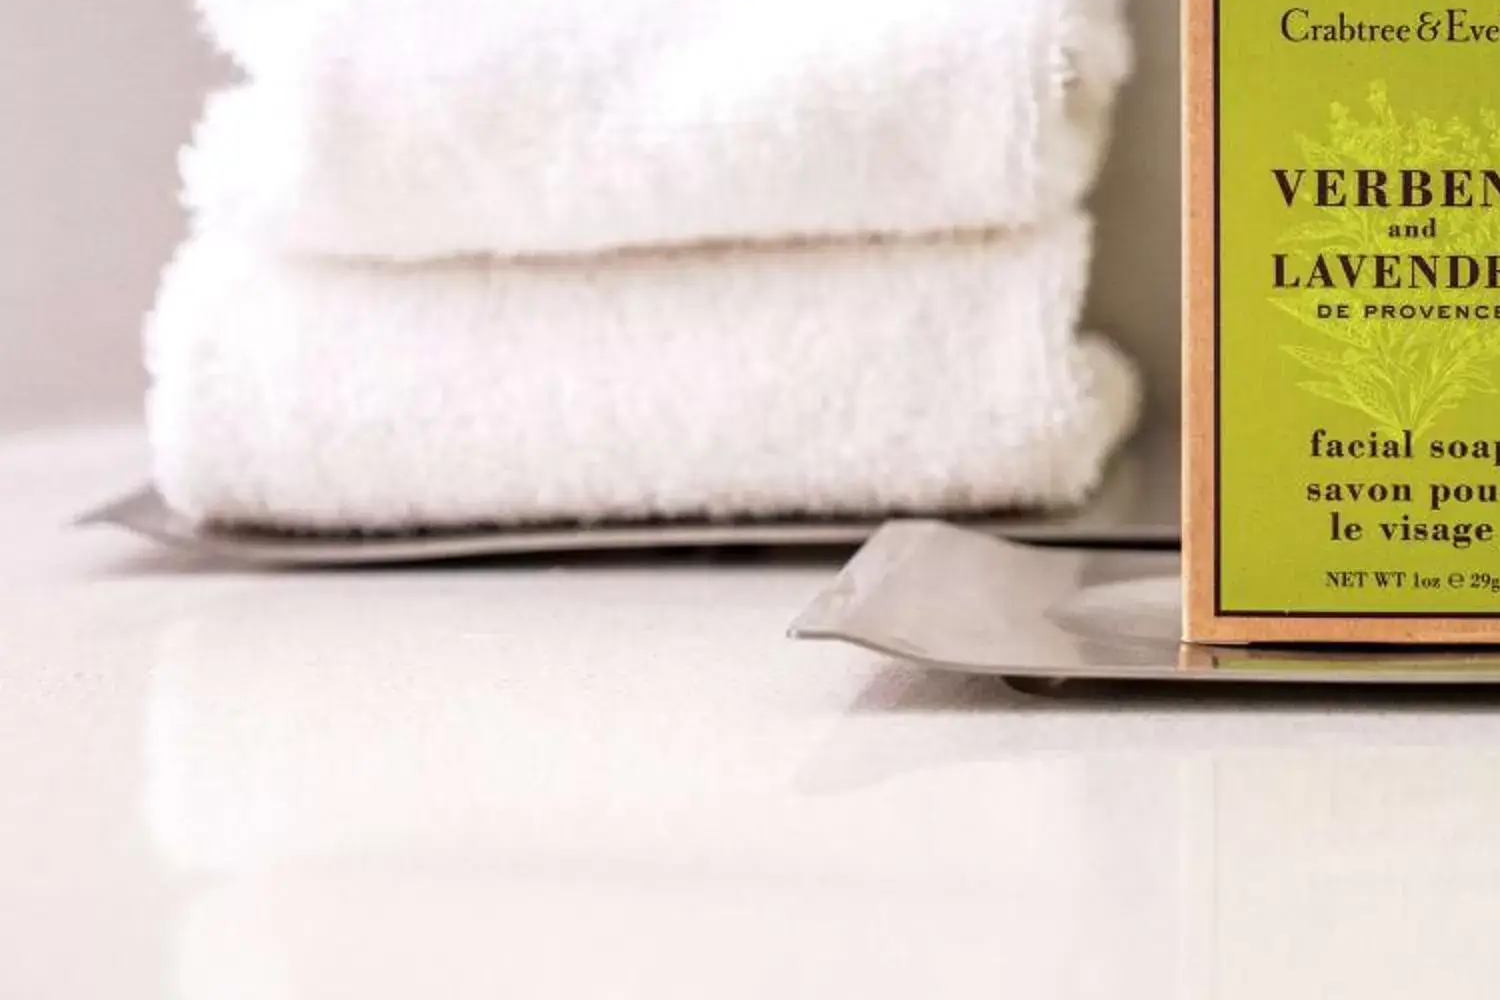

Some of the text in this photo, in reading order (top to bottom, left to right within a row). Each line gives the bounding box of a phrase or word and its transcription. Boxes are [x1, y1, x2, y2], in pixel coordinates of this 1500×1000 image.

[1280, 7, 1410, 43] Crabtree
[1416, 11, 1441, 42] &
[1387, 217, 1437, 239] and
[1316, 303, 1350, 320] DE
[1310, 428, 1413, 459] facial
[1306, 483, 1412, 503] savon
[1330, 511, 1496, 549] le visage
[1325, 571, 1369, 588] NET
[1372, 571, 1407, 588] WT
